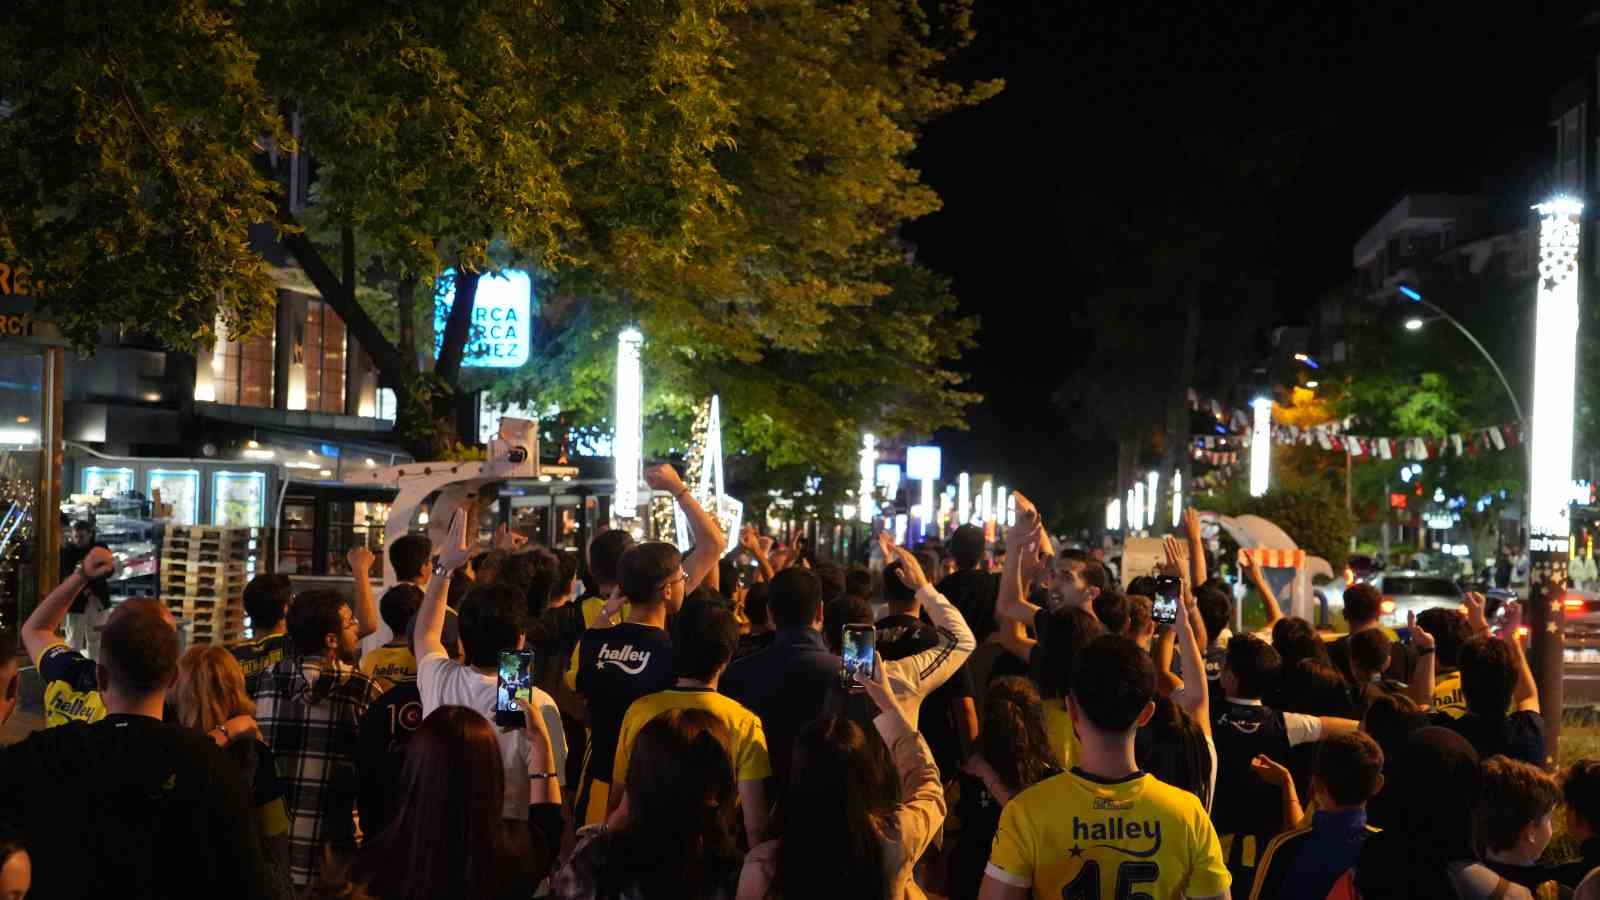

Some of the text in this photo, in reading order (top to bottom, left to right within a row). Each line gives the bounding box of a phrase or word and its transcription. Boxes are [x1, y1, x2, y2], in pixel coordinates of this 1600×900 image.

[476, 307, 517, 321] RCA
[475, 325, 516, 339] RCA
[598, 643, 651, 674] halley
[50, 690, 95, 723] halley
[1433, 688, 1462, 706] hall
[1072, 816, 1162, 857] halley
